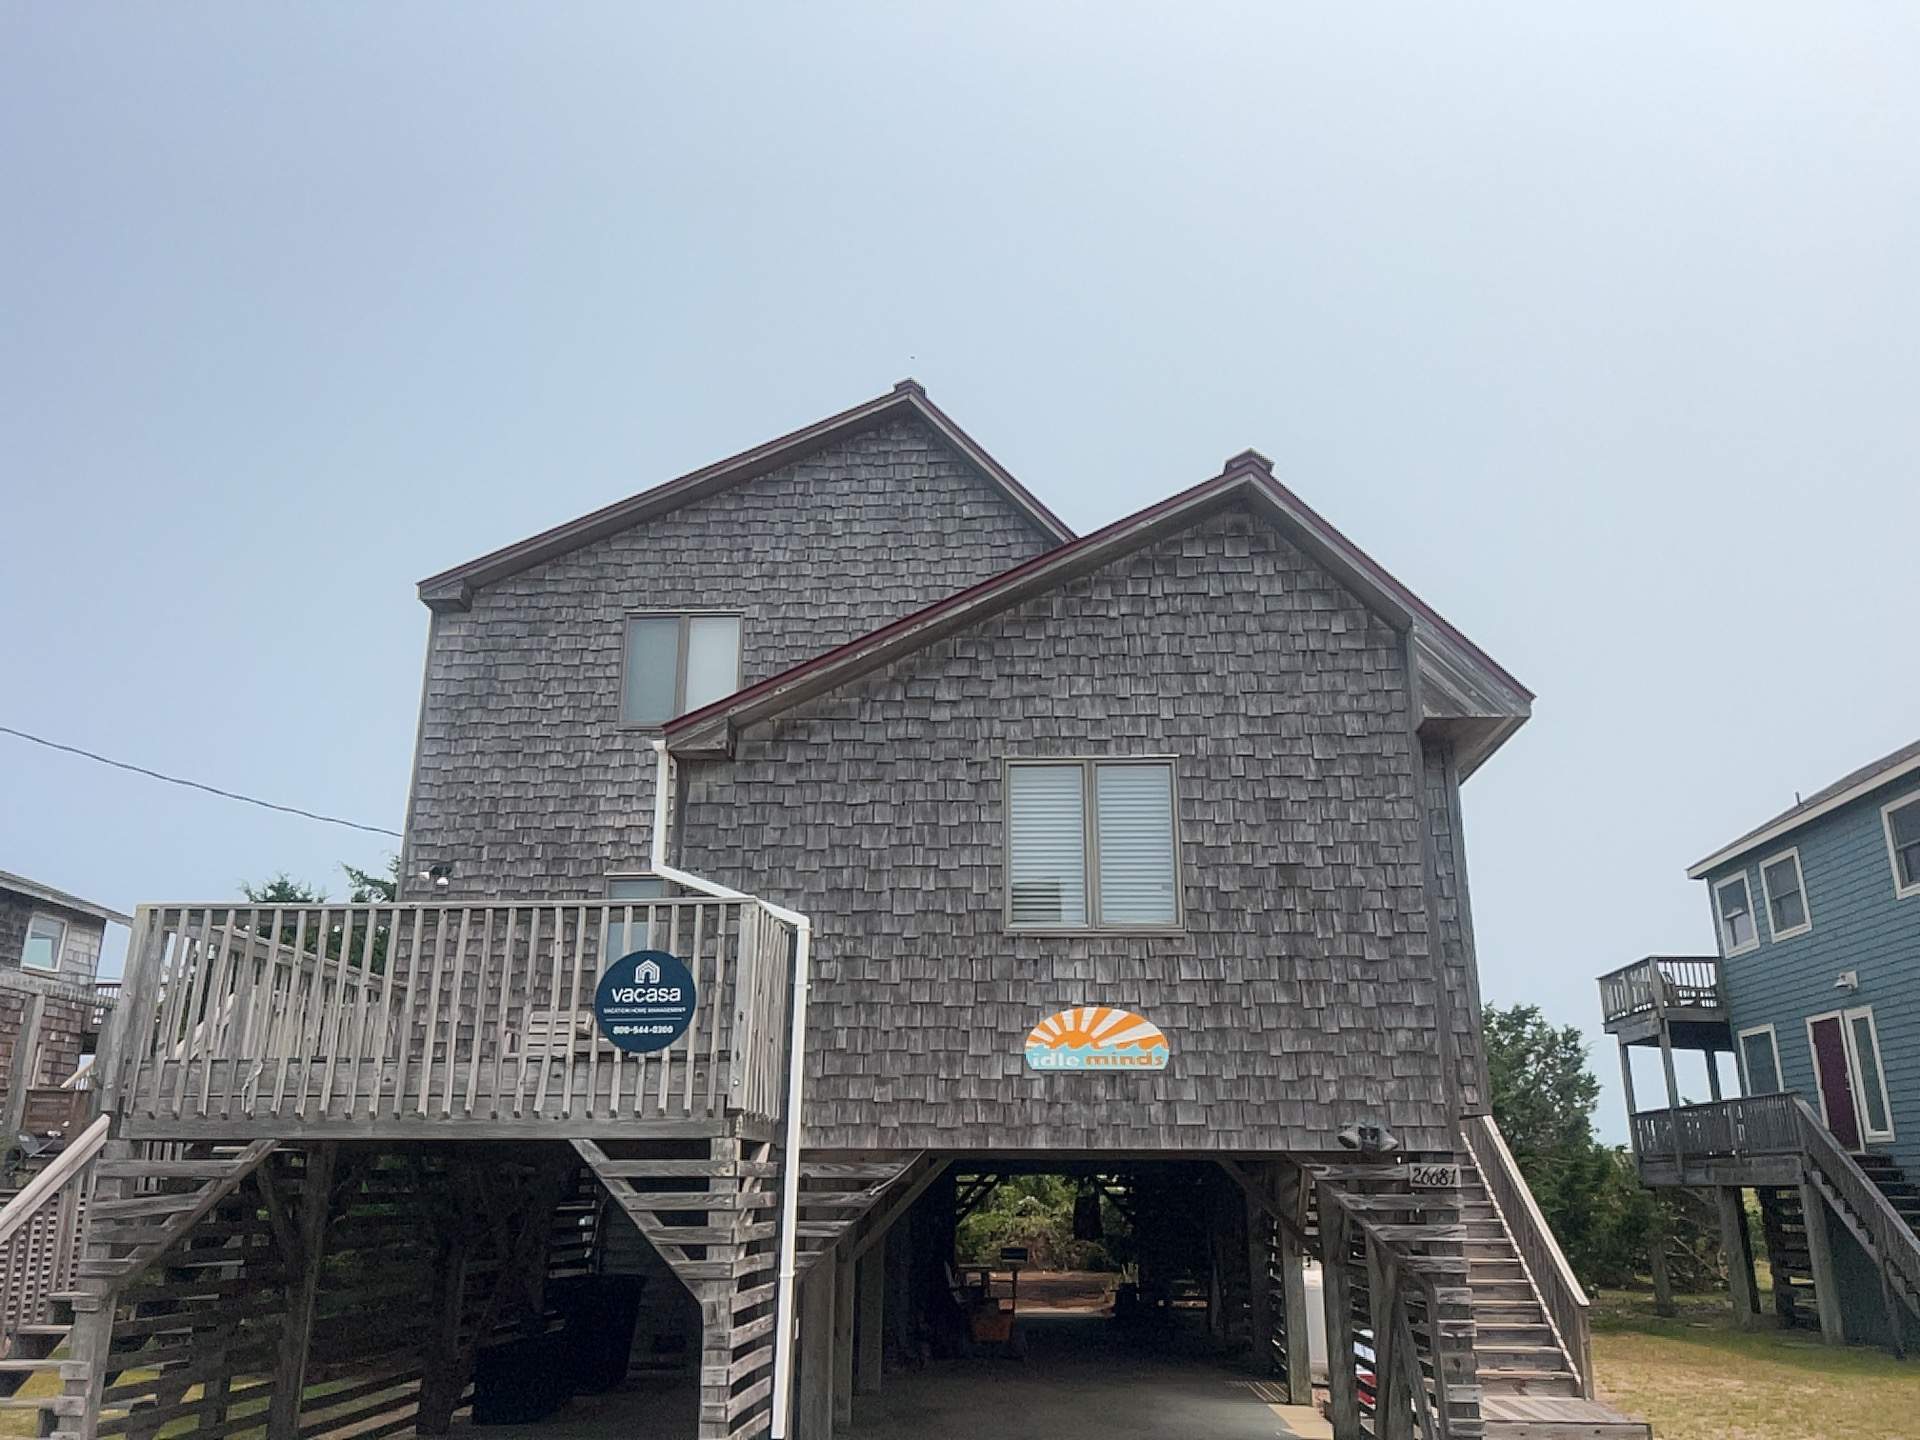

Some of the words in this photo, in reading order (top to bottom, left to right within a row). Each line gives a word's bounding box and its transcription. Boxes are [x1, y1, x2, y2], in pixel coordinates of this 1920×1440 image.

[612, 987, 681, 1003] vacasa
[1032, 1053, 1080, 1067] idle
[1086, 1052, 1164, 1067] minds
[1412, 1167, 1457, 1186] 26681
